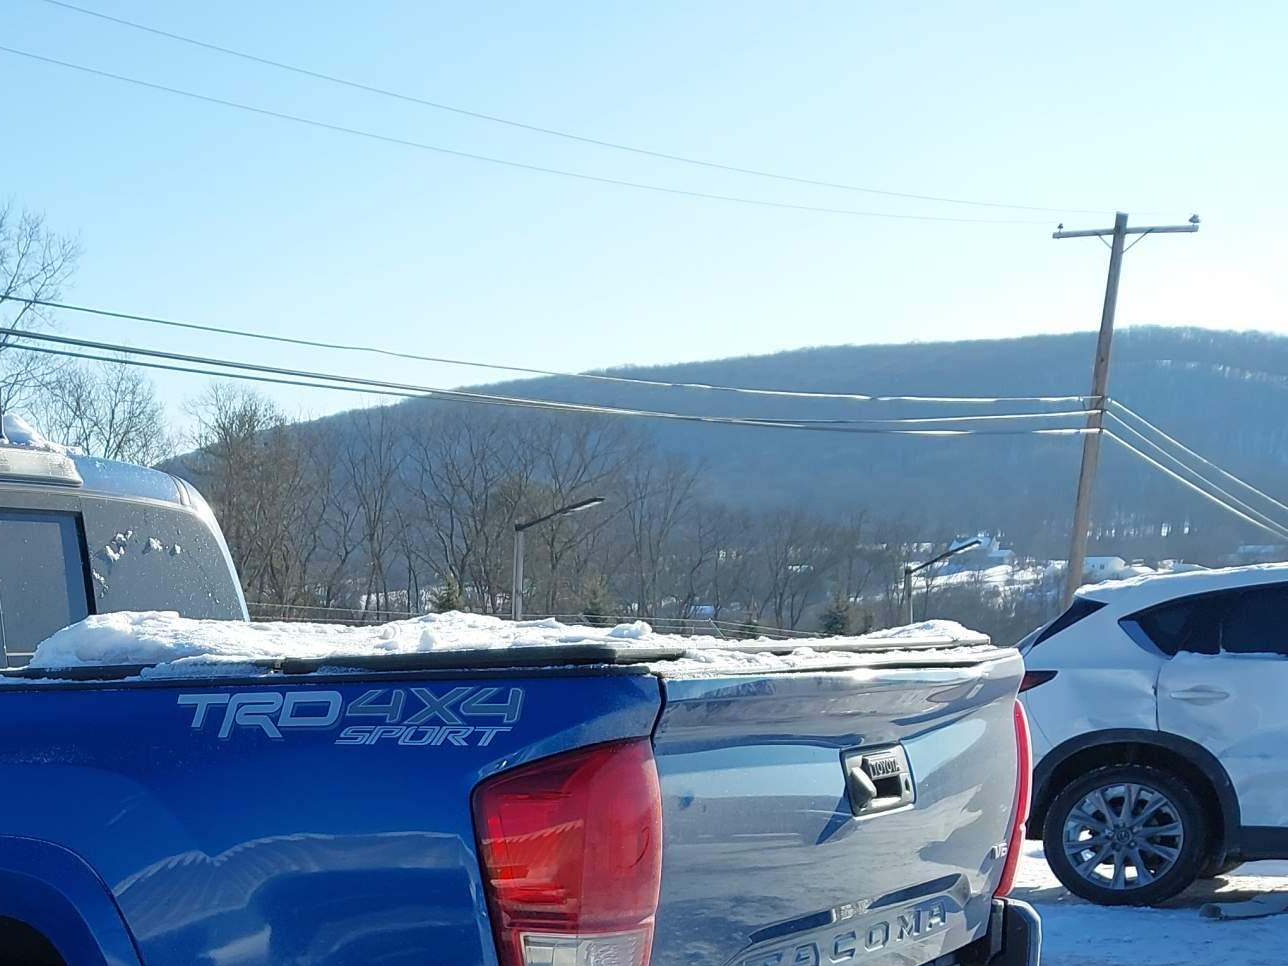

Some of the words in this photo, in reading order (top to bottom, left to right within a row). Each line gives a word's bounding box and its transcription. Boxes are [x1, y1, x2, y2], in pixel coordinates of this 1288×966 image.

[176, 690, 345, 740] TRD
[333, 725, 513, 747] SPORT
[991, 842, 1008, 860] V6
